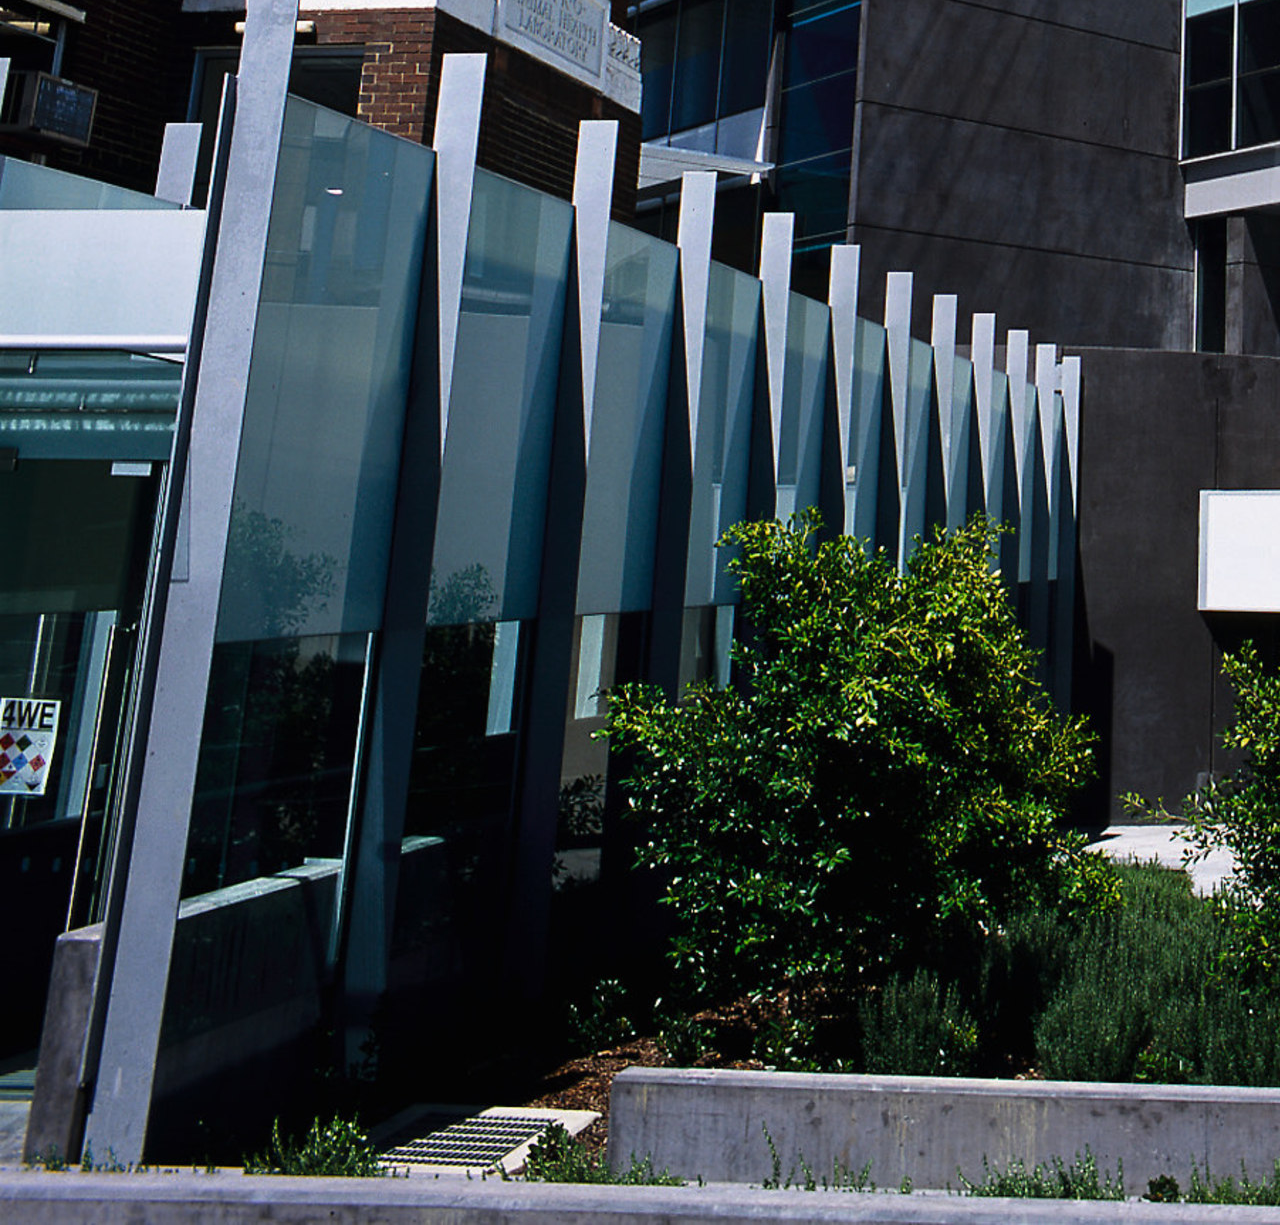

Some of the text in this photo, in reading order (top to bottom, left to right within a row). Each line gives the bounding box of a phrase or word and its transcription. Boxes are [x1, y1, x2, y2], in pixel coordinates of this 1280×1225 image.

[518, 8, 588, 63] LABORATORY
[558, 8, 597, 47] HEALTH
[2, 700, 56, 729] 4WE
